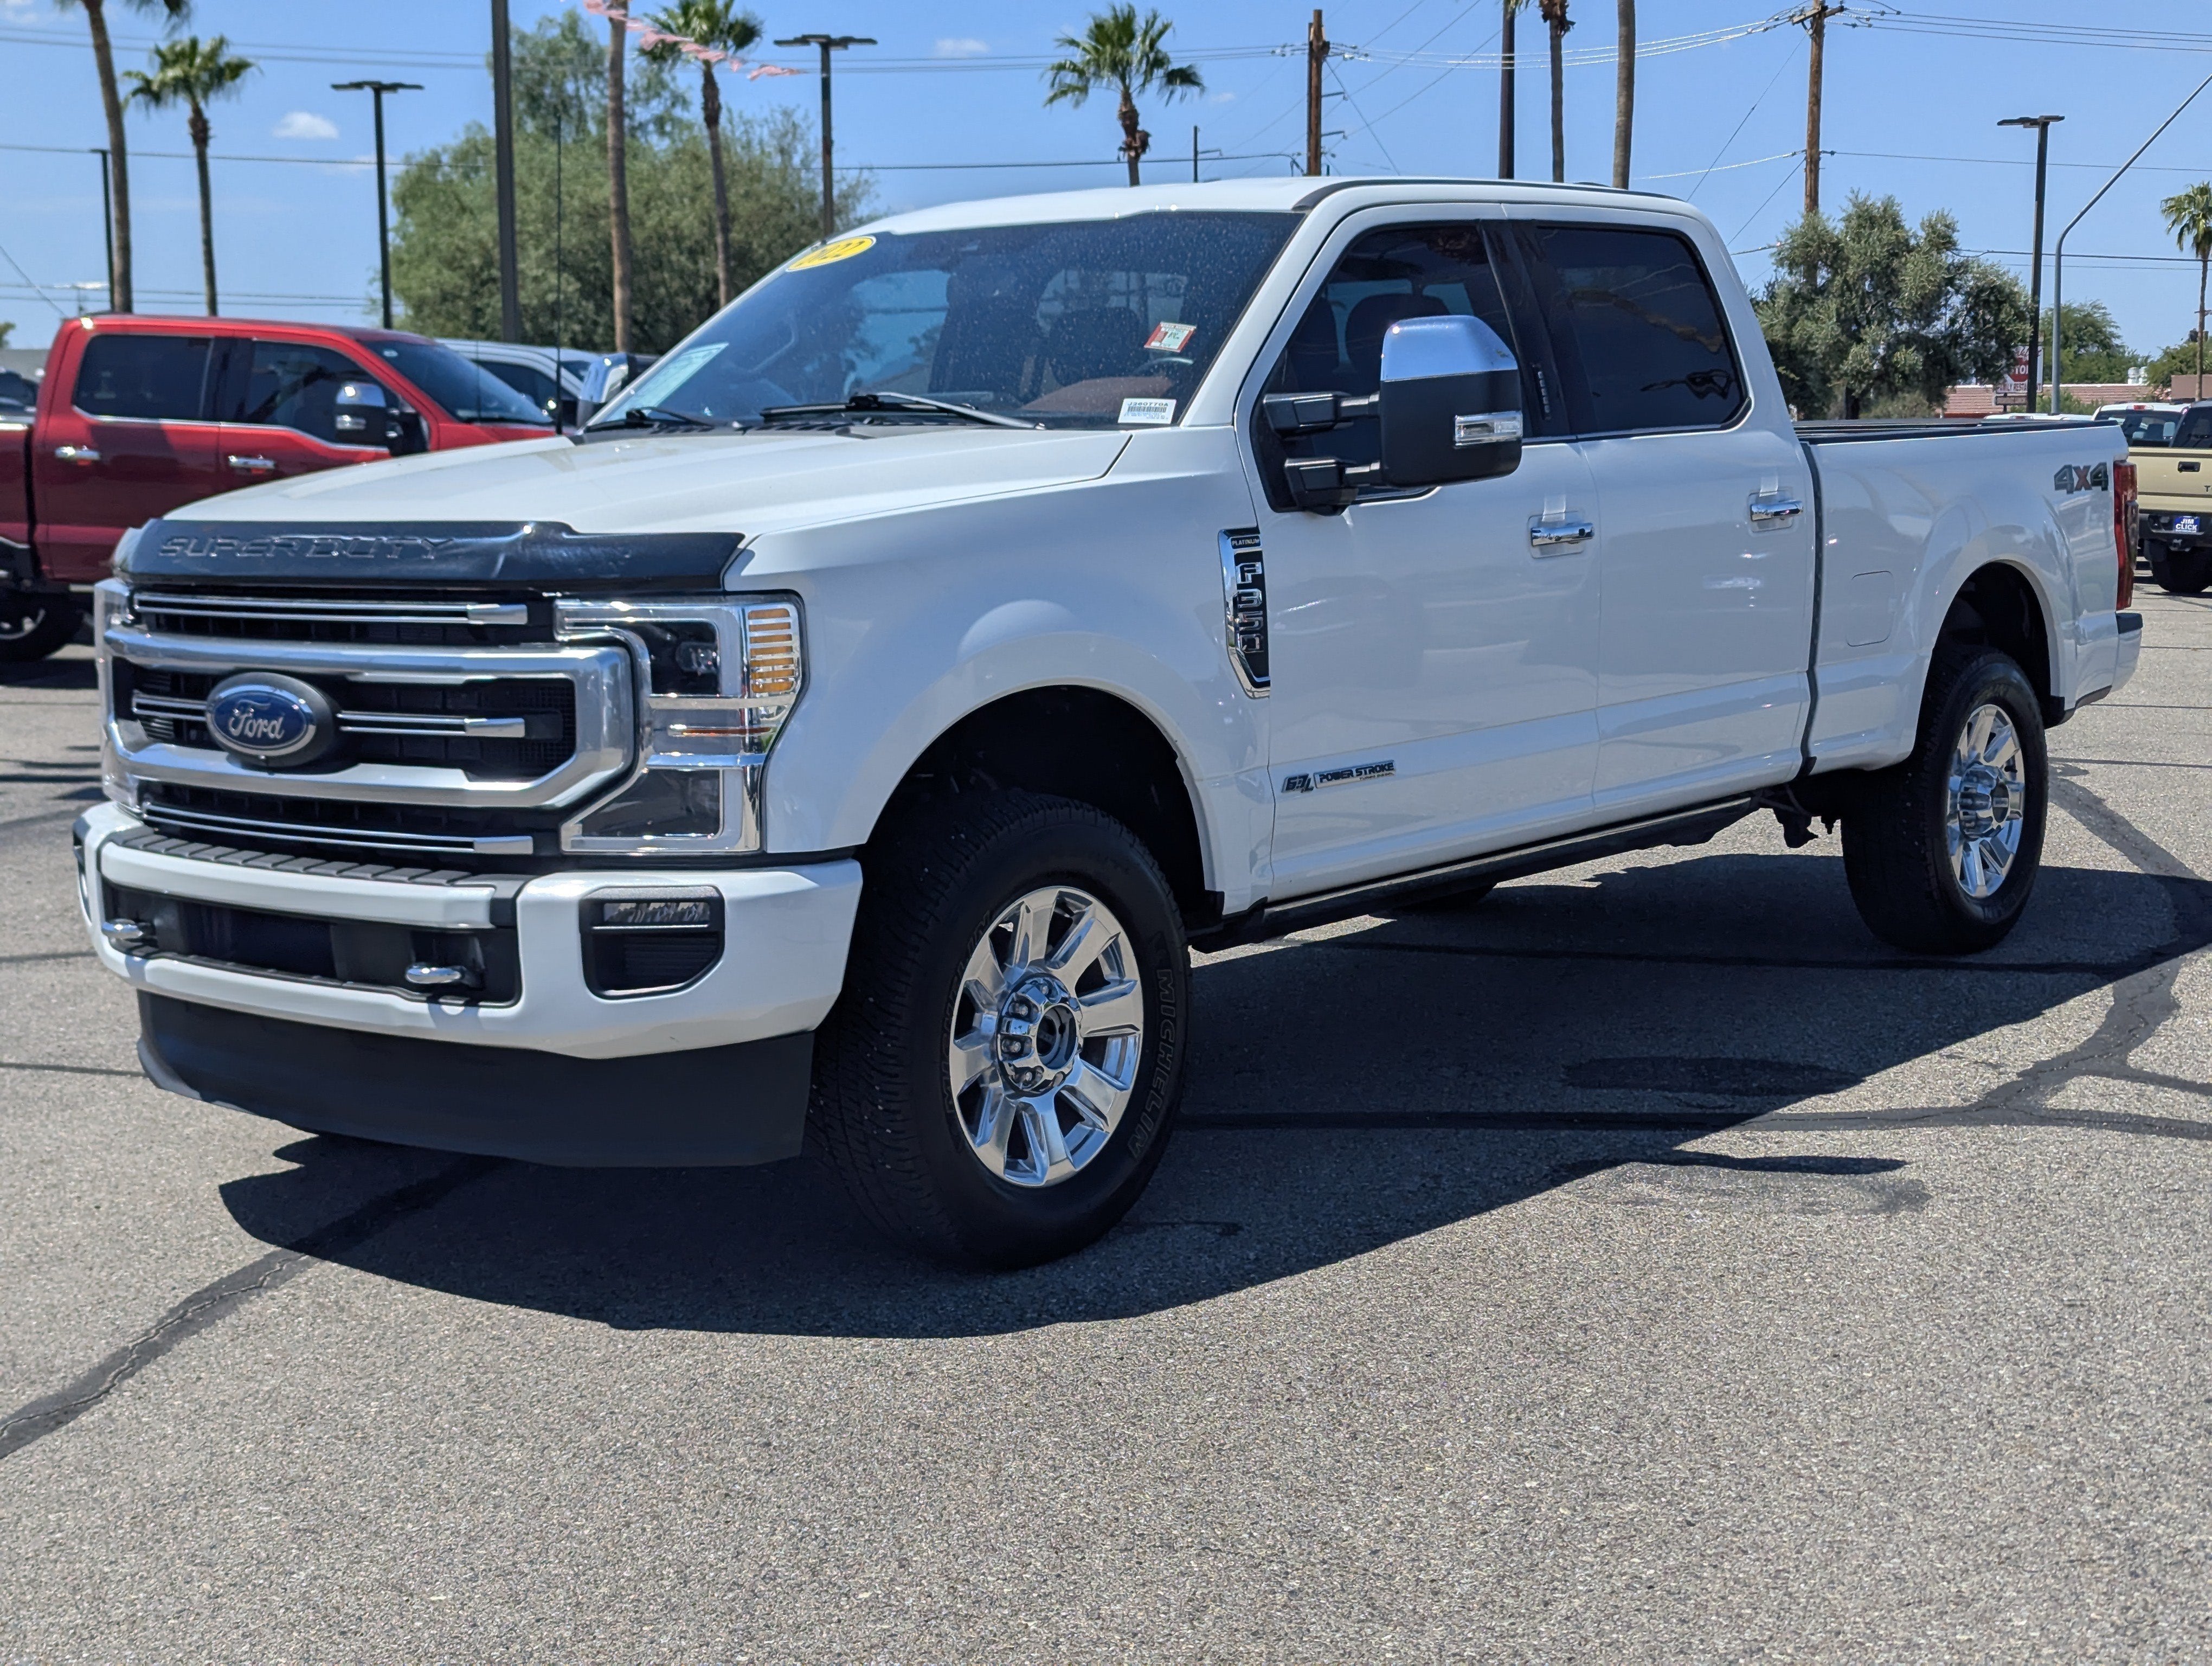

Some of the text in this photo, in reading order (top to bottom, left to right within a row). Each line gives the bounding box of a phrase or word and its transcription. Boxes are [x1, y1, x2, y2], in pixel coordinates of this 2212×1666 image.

[159, 535, 453, 559] SUPER DUTY
[1231, 538, 1261, 546] PLATINUM
[229, 699, 285, 740] Ford
[1319, 769, 1354, 783] POWER
[1355, 762, 1394, 777] STROKE
[1127, 969, 1176, 1159] MICHELIN
